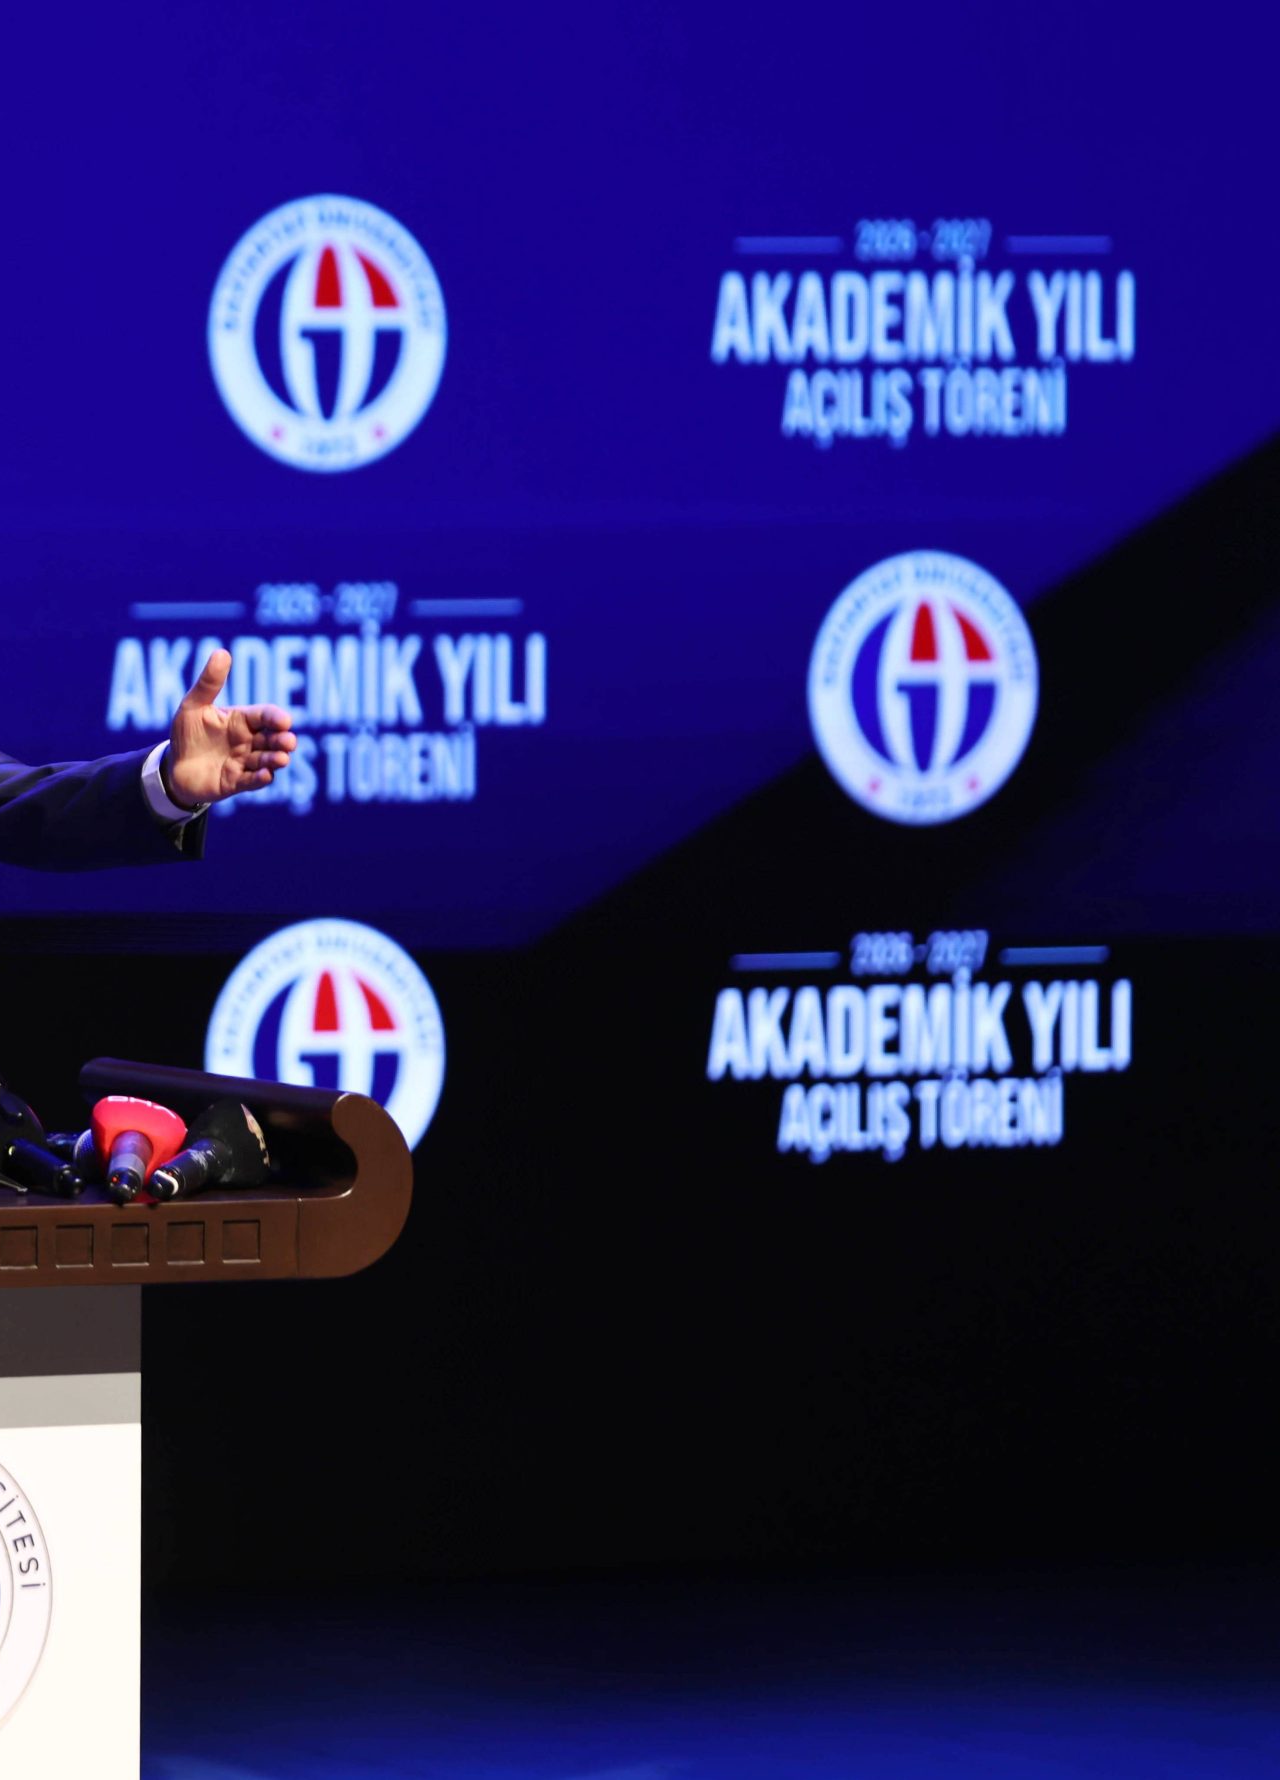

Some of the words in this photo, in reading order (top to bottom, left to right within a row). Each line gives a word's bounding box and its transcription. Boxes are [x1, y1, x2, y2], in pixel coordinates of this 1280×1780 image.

[711, 255, 1015, 364] AKADEMİK
[1028, 269, 1135, 362] YILI
[781, 367, 914, 446] AÇILIŞ
[919, 357, 1066, 436] TÖRENİ
[434, 633, 547, 726] YILI
[321, 722, 476, 801] TÖRENİ
[707, 966, 1013, 1080] AKADEMİK
[1023, 979, 1131, 1074] YILI
[777, 1081, 910, 1163] AÇILIŞ
[914, 1066, 1063, 1148] TÖRENİ
